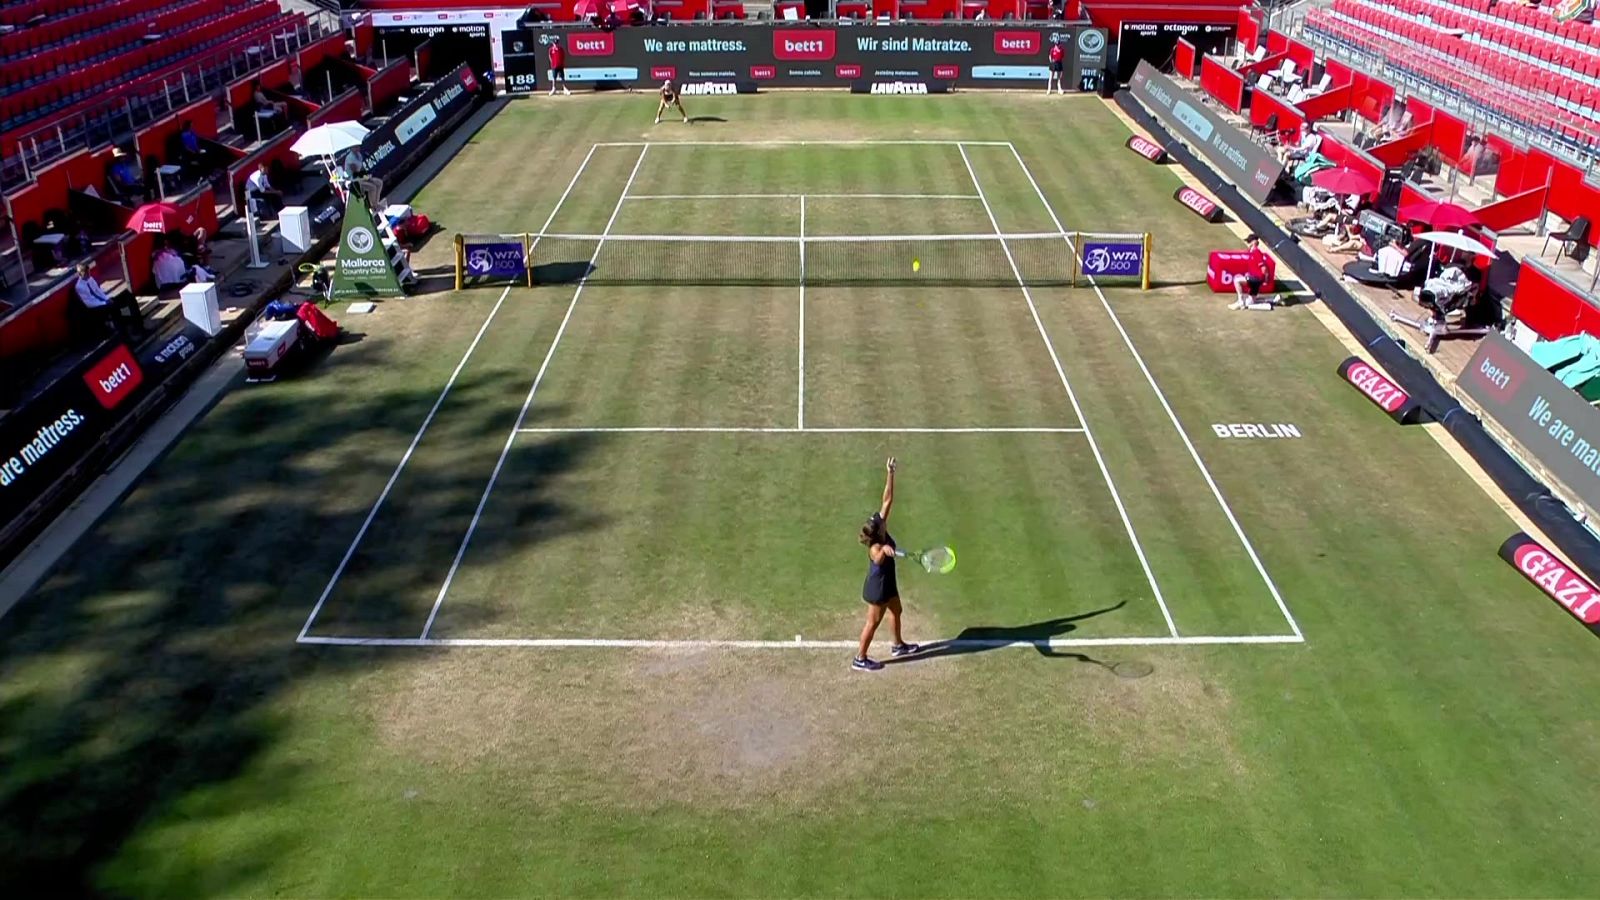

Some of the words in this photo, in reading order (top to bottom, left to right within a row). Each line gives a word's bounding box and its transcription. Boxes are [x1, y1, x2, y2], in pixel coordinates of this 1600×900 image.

[410, 26, 444, 37] octagon
[1163, 24, 1198, 35] octagon
[576, 40, 605, 50] bett1
[643, 39, 663, 52] We
[666, 41, 685, 51] are
[689, 39, 746, 51] mattress.
[784, 39, 823, 52] bett1
[857, 37, 878, 51] Wir
[882, 37, 908, 51] sind
[912, 38, 972, 52] Matratze.
[1002, 39, 1031, 49] bett1
[507, 74, 535, 85] 188
[1082, 78, 1094, 90] 14
[680, 81, 738, 95] LAVAZZA
[870, 81, 928, 94] LAVAZZA
[1181, 189, 1212, 217] GAZI
[494, 251, 521, 260] WTA
[1112, 252, 1138, 260] WTA
[341, 258, 386, 268] Mallorca
[1110, 261, 1131, 270] 500
[99, 362, 131, 393] bett1
[1480, 357, 1510, 390] bett1
[1351, 366, 1403, 412] GAZI
[1211, 423, 1302, 438] BERLIN
[1528, 396, 1552, 427] We
[1548, 419, 1575, 447] are
[1571, 438, 1600, 477] mat
[0, 457, 24, 486] are
[20, 409, 85, 466] mattress.
[1521, 550, 1600, 620] GAZI
